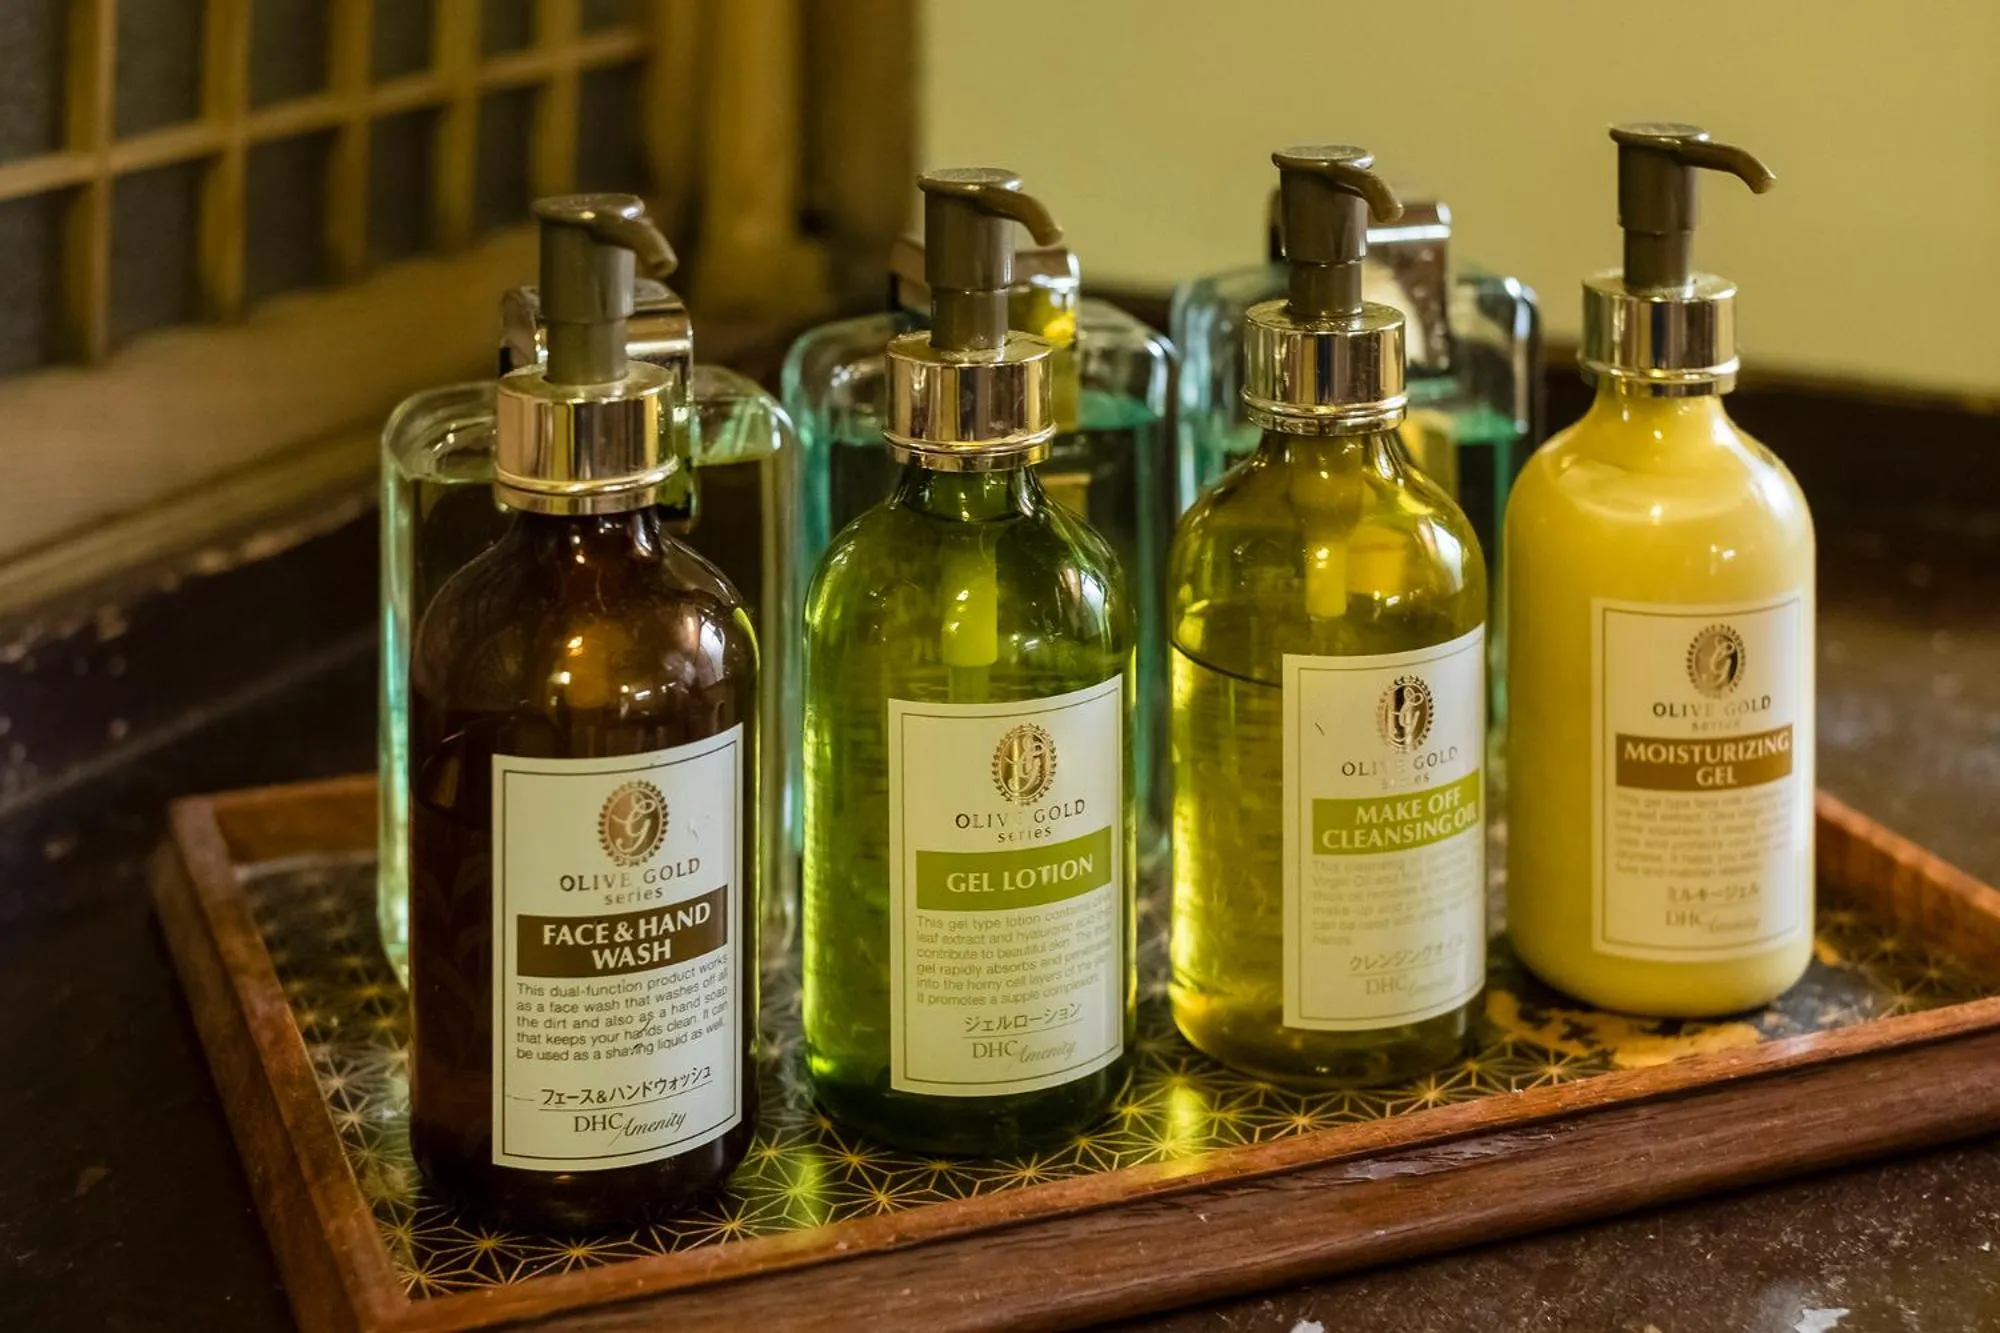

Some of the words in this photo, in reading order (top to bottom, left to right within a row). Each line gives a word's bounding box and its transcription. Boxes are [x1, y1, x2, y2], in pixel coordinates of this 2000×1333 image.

[1653, 702, 1715, 718] OLIVE
[1724, 695, 1771, 717] GOLD
[1413, 746, 1458, 770] GOLD
[1624, 731, 1790, 765] MOISTURIZING
[1696, 765, 1738, 787] GEL
[1034, 799, 1085, 824] GOLD
[1355, 799, 1423, 825] MAKE
[1428, 786, 1462, 815] OFF
[1322, 814, 1452, 849] CLEANSING
[560, 872, 632, 892] OLIVE
[643, 857, 700, 884] GOLD
[946, 872, 994, 893] GEL
[1003, 853, 1093, 891] LOTION
[604, 887, 663, 905] series
[543, 923, 609, 945] FACE
[638, 901, 711, 939] HAND
[916, 916, 943, 929] This
[949, 918, 967, 933] gel
[973, 918, 1000, 932] type
[1006, 913, 1041, 928] lotion
[916, 931, 938, 944] leaf
[942, 932, 985, 946] extract
[989, 932, 1013, 945] and
[592, 939, 671, 970] WASH
[917, 946, 978, 960] contribute
[982, 947, 994, 960] to
[917, 962, 935, 976] gel
[940, 962, 982, 977] rapidly
[986, 959, 1036, 975] absorbs
[1040, 954, 1062, 968] and
[517, 982, 544, 996] This
[551, 979, 642, 997] dual-function
[647, 966, 696, 990] product
[699, 954, 728, 974] works
[917, 977, 939, 990] into
[944, 977, 962, 991] the
[1029, 970, 1061, 986] layers
[517, 1001, 531, 1012] as
[537, 1003, 544, 1013] a
[549, 1000, 579, 1013] face
[584, 999, 621, 1013] wash
[625, 993, 651, 1008] that
[655, 982, 699, 1003] washes
[703, 973, 716, 988] off
[917, 991, 924, 1004] It
[928, 991, 986, 1007] promotes
[990, 993, 997, 1005] a
[517, 1015, 539, 1028] the
[544, 1015, 567, 1029] dirt
[573, 1015, 599, 1029] and
[605, 1013, 634, 1028] also
[639, 1009, 654, 1023] as
[659, 1008, 667, 1019] a
[671, 996, 701, 1015] hand
[965, 1003, 1082, 1032] ジェルローション
[517, 1032, 541, 1045] that
[546, 1032, 586, 1047] keeps
[591, 1032, 620, 1047] your
[624, 1023, 663, 1040] hands
[517, 1047, 533, 1060] be
[537, 1047, 568, 1061] used
[573, 1049, 589, 1061] as
[593, 1049, 601, 1060] a
[605, 1041, 654, 1059] shaving
[657, 1031, 688, 1050] liquid
[691, 1026, 703, 1040] as
[972, 1040, 1018, 1059] DHC
[574, 1112, 623, 1133] DHC
[608, 1111, 687, 1147] Amenity
